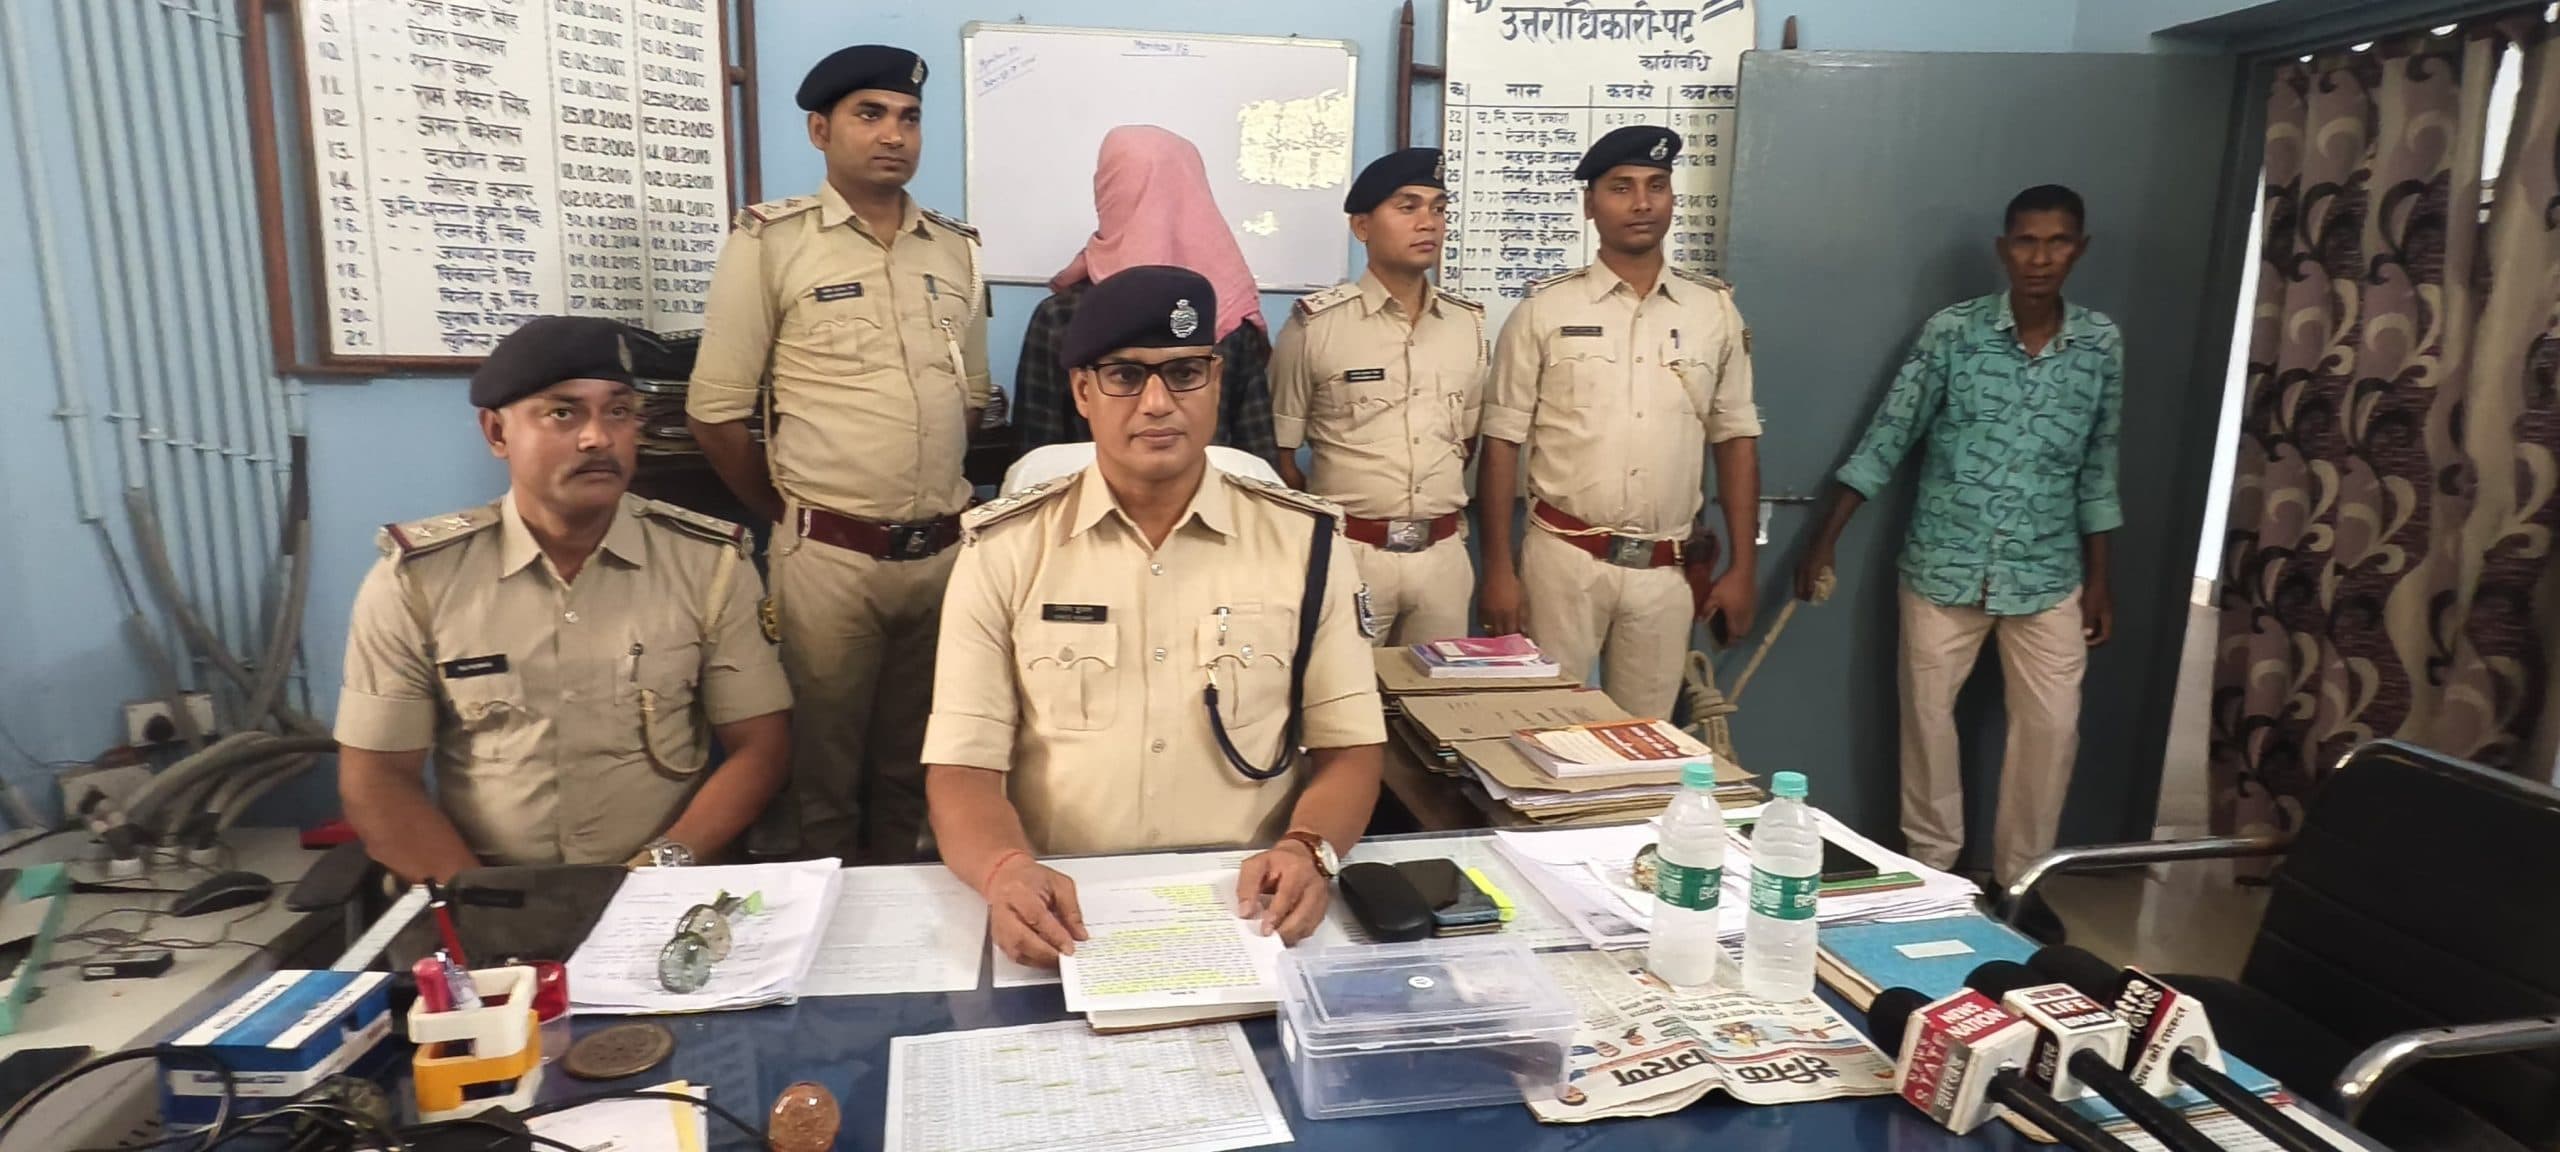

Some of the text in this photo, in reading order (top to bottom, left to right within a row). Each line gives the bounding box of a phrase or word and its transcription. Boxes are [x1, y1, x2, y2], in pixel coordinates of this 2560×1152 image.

[1506, 83, 1544, 99] नाम
[1937, 1001, 1985, 1024] NEWS
[2039, 998, 2095, 1016] LIFE
[1945, 1007, 2009, 1040] NATION
[1610, 1049, 1841, 1088] दैनिक ागरण
